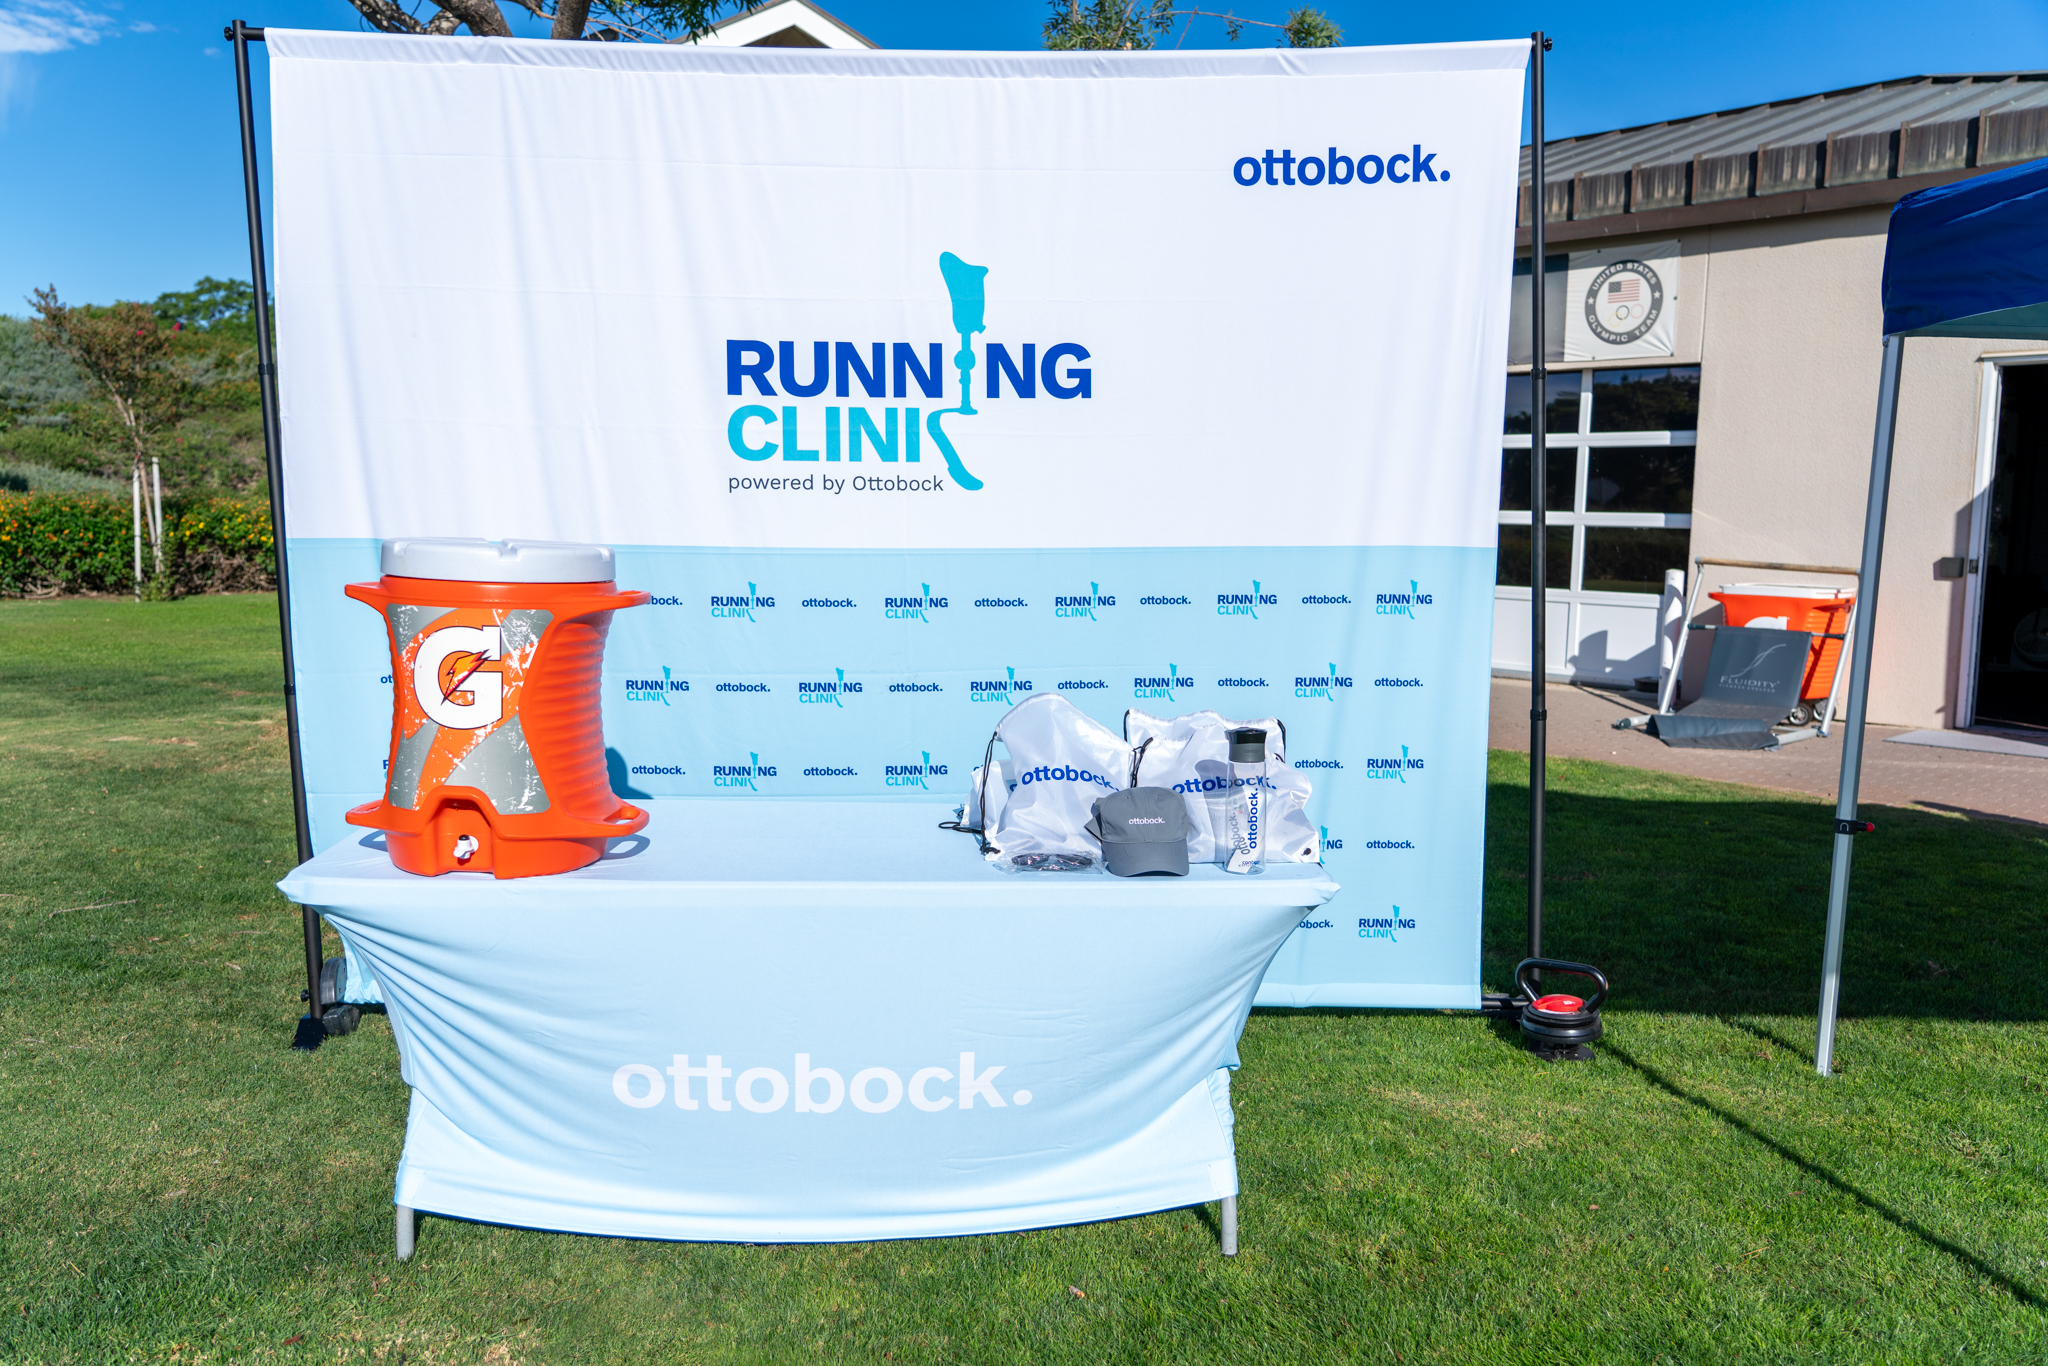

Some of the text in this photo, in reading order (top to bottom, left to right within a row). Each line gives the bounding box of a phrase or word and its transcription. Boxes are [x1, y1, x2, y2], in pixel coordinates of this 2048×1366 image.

[1233, 144, 1451, 187] ottobock.
[1592, 262, 1657, 291] UNITED STATES
[1589, 309, 1658, 342] OLYMPIC TEAM
[729, 474, 944, 494] powered by Ottobock
[646, 595, 683, 606] bock.
[801, 597, 858, 608] ottobock.
[974, 597, 1028, 608] ottobock.
[1139, 595, 1192, 605] ottobock.
[1301, 594, 1352, 605] ottobock.
[414, 625, 503, 730] G
[1217, 677, 1270, 687] ottobock.
[1374, 677, 1424, 687] ottobock.
[715, 682, 771, 693] ottobock.
[888, 682, 943, 693] ottobock.
[1057, 679, 1109, 690] ottobock.
[1294, 758, 1344, 769] ottobock.
[631, 765, 686, 776] ottobock.
[803, 766, 858, 777] ottobock.
[1021, 765, 1119, 792] ottobock.
[1128, 816, 1166, 825] ottobock.
[1247, 787, 1259, 850] ottobock.
[1366, 839, 1415, 849] ottobock.
[1296, 919, 1334, 929] obock.
[612, 1051, 1033, 1114] ottobock.
